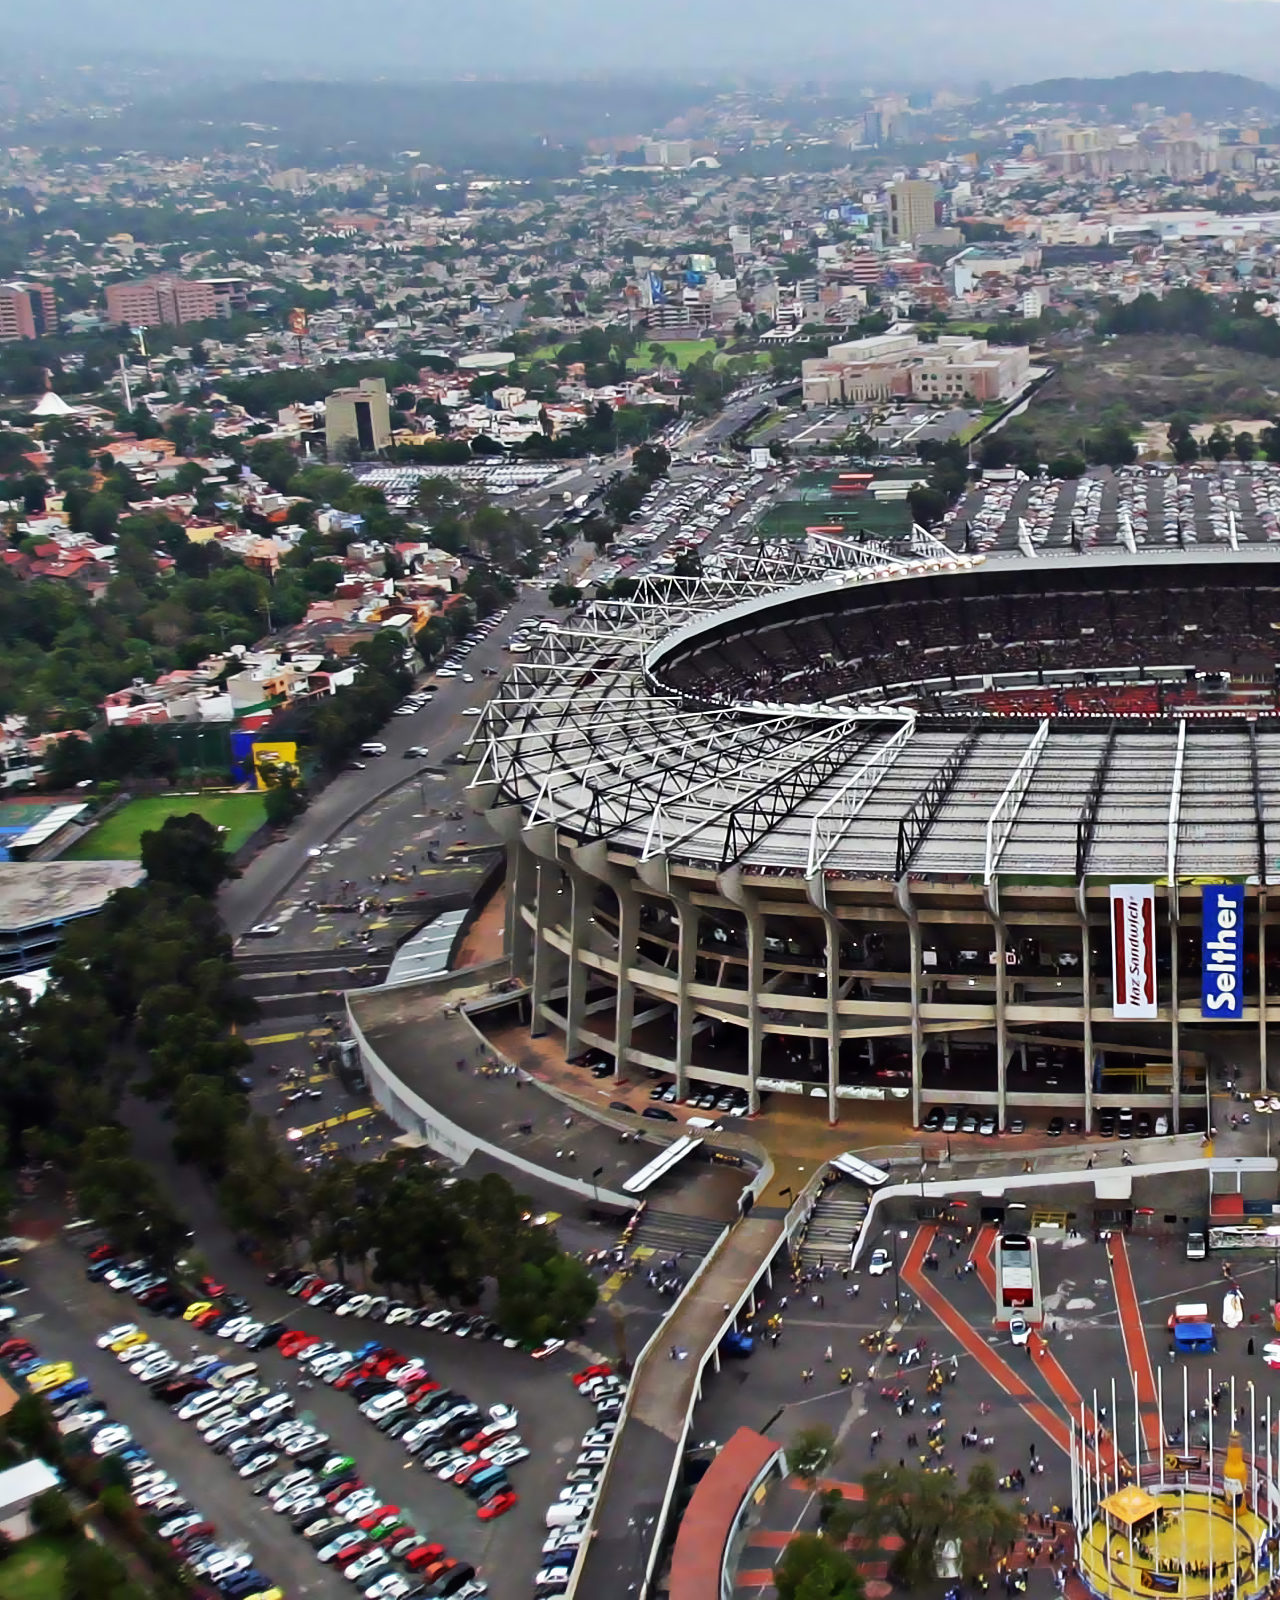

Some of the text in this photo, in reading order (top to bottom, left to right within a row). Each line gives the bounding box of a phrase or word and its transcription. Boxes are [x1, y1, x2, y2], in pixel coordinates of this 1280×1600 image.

[1127, 899, 1141, 1006] Haz Sandwich
[1206, 894, 1237, 1011] Selther
